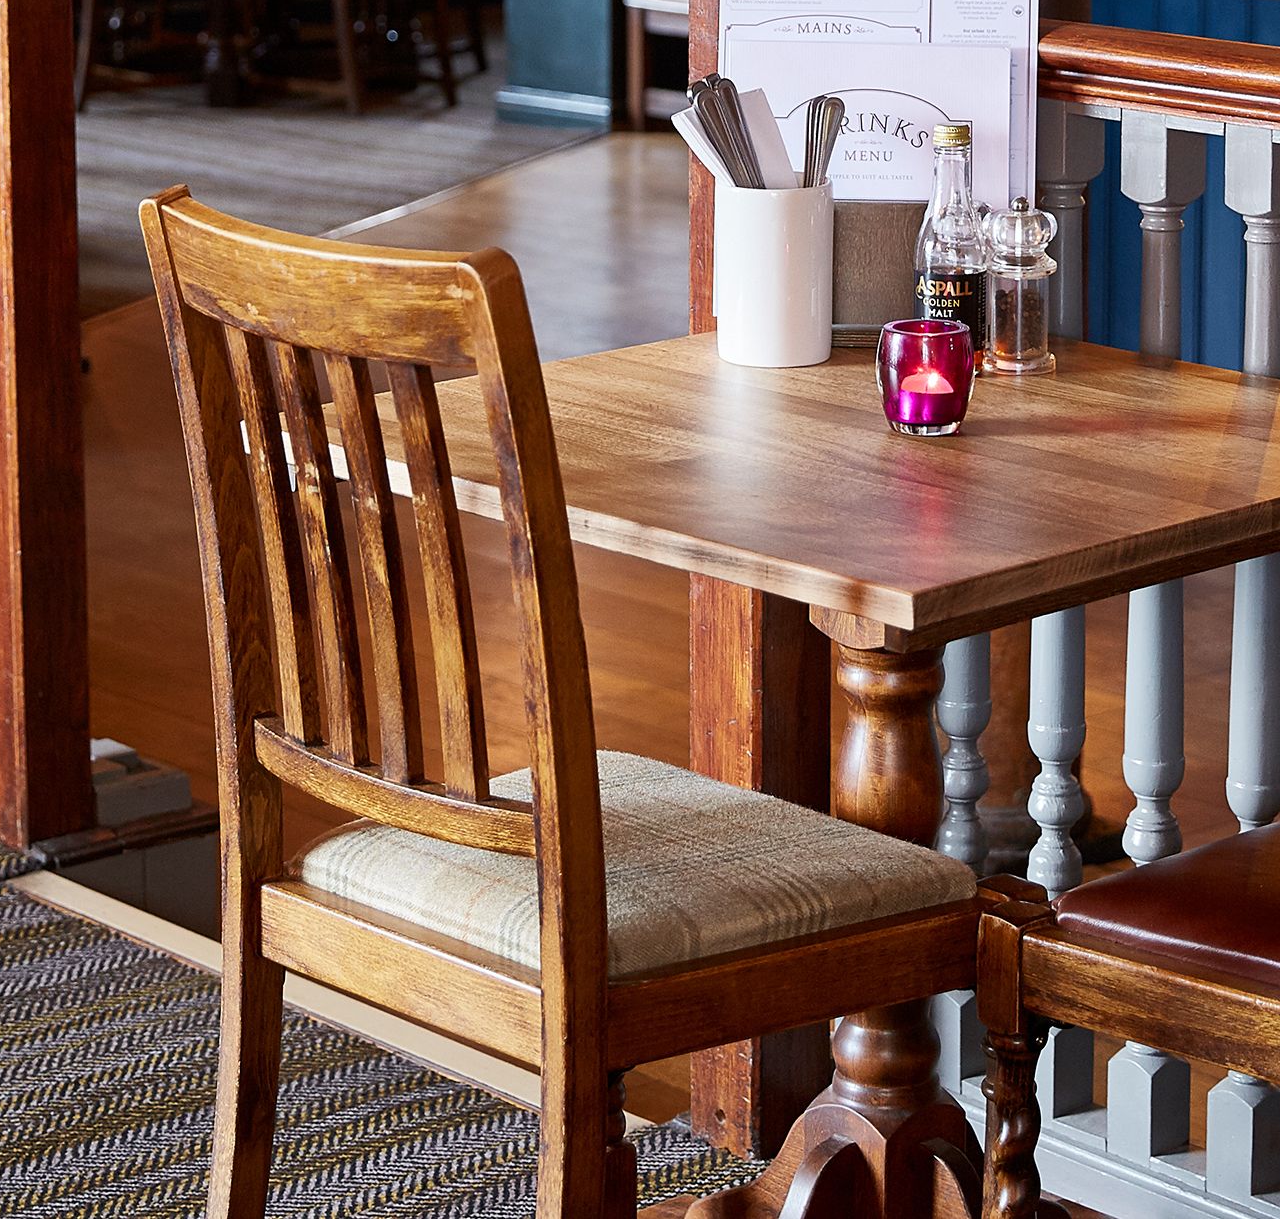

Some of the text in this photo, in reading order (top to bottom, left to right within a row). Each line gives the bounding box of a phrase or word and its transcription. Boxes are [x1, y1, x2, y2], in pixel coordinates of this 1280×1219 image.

[797, 22, 852, 35] MAINS
[839, 112, 929, 148] RINKS
[844, 150, 893, 162] MENU
[916, 276, 973, 299] ASPALL
[923, 298, 960, 308] GOLDEN
[928, 309, 954, 318] MALT
